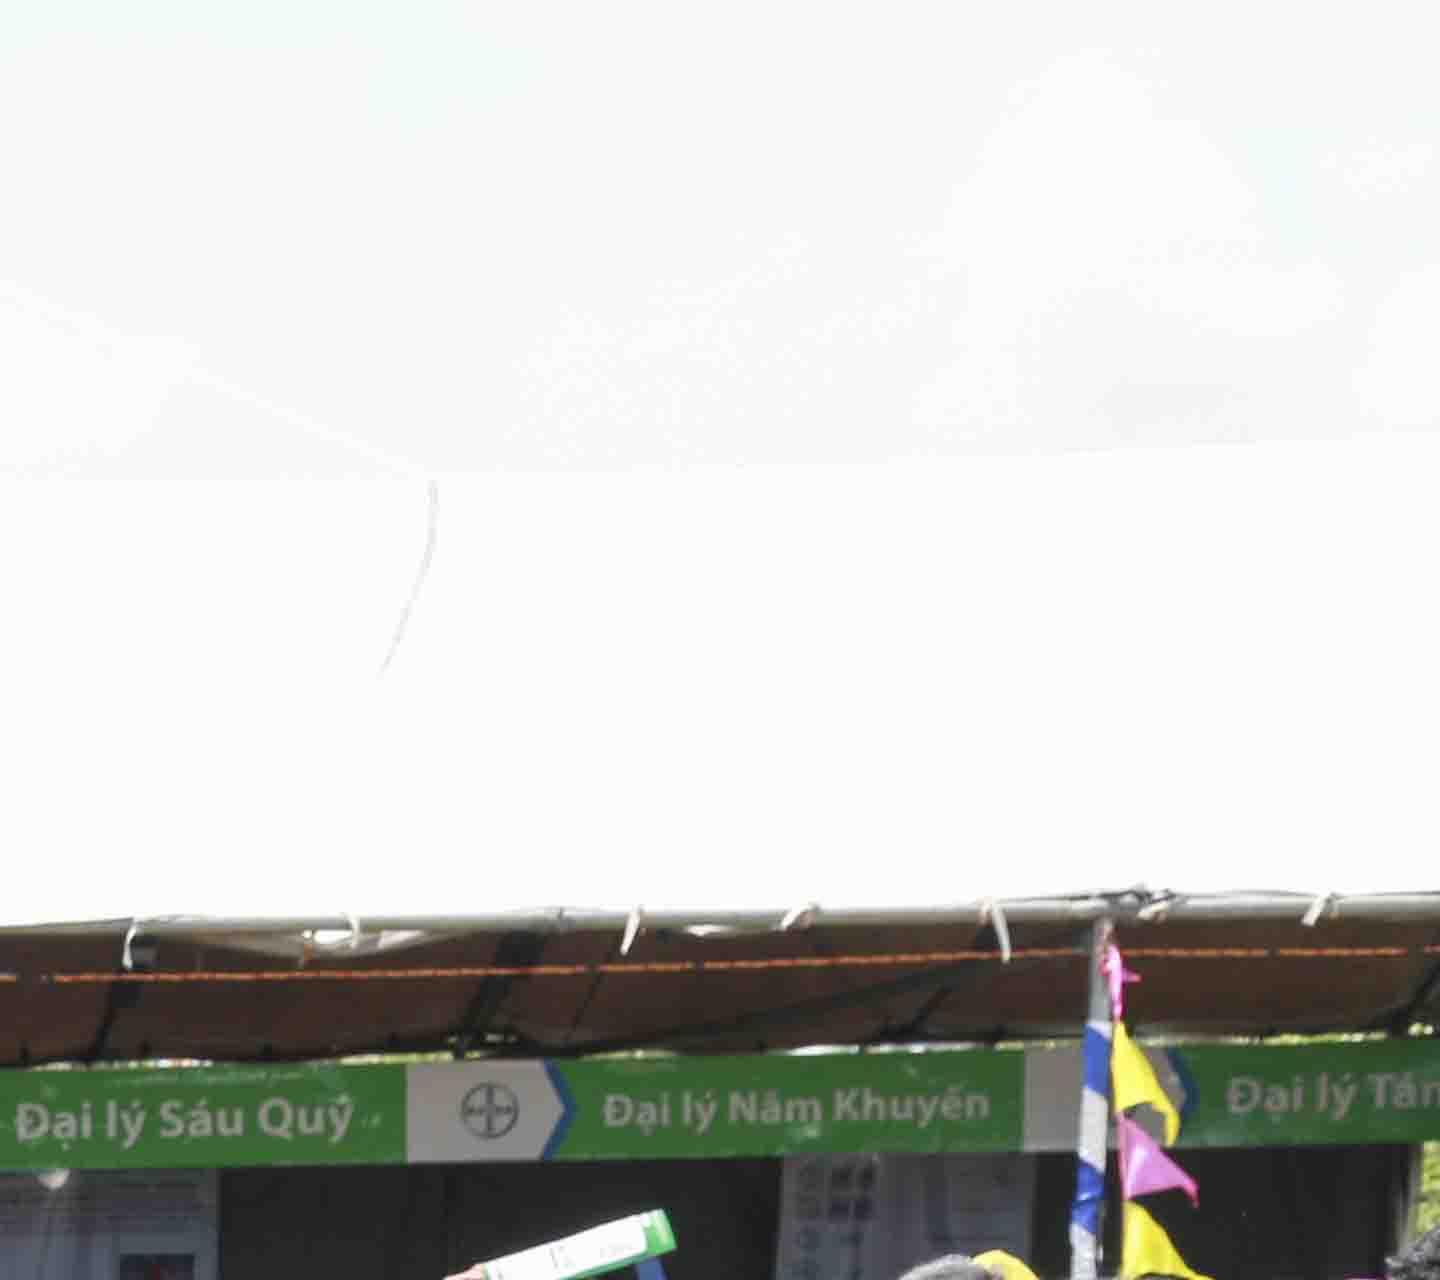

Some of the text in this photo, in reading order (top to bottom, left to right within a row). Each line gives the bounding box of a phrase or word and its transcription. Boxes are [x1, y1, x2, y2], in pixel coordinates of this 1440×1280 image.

[603, 1093, 671, 1136] Đại
[683, 1091, 717, 1134] lý
[729, 1090, 822, 1124] Năm
[1227, 1077, 1303, 1120] Đại
[1315, 1072, 1356, 1120] lý
[15, 1102, 92, 1149] Đại
[106, 1101, 145, 1148] lý
[160, 1100, 243, 1137] Sáu
